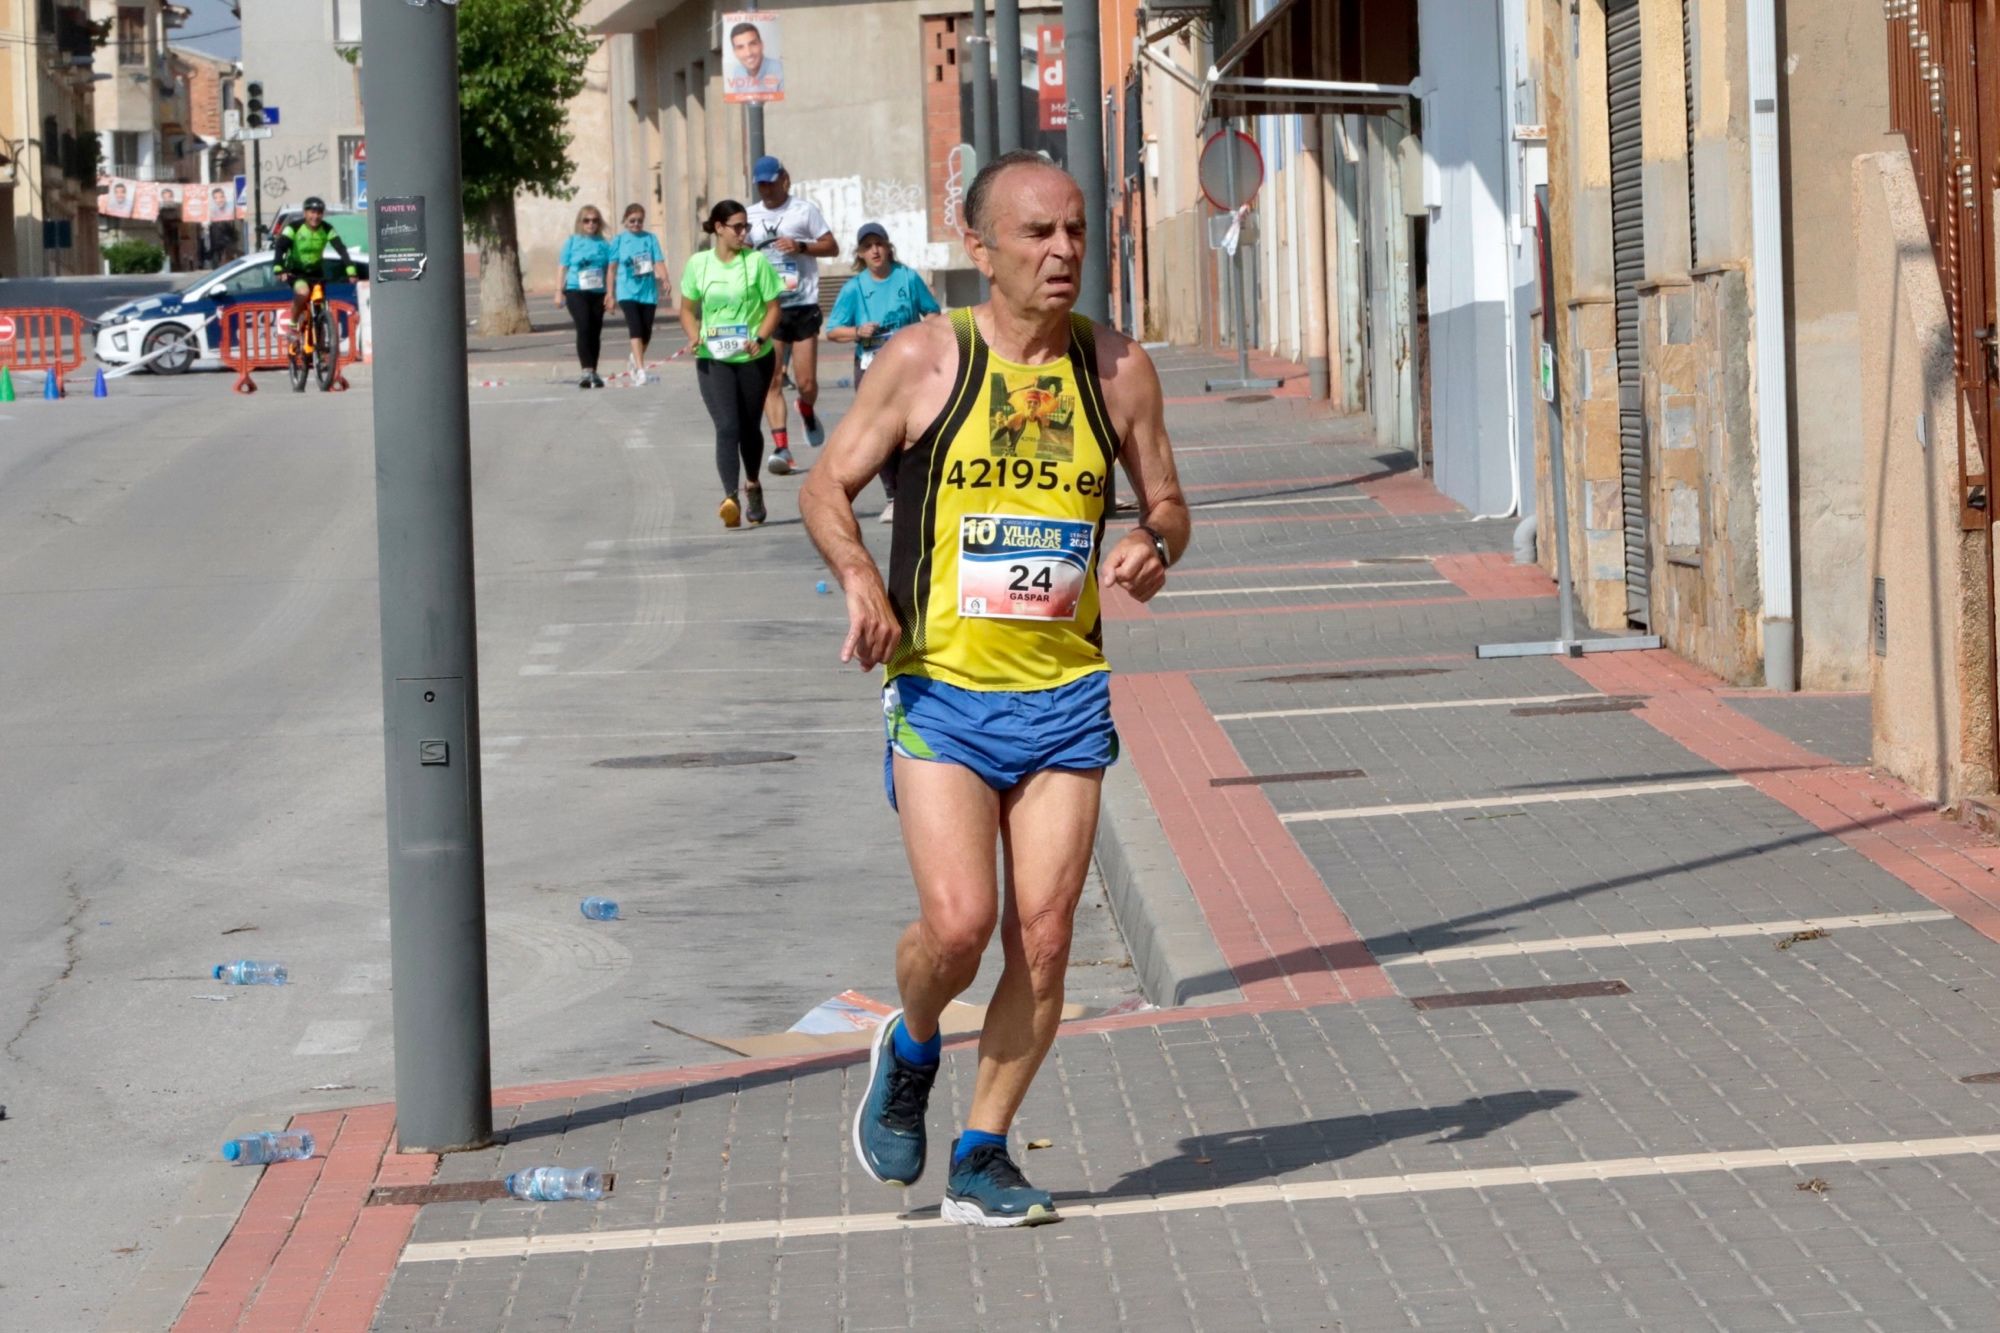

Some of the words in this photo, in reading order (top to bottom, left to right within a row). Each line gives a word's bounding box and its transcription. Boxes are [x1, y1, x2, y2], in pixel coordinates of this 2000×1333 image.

[717, 340, 738, 350] 389
[946, 458, 1105, 498] 42195.es
[1002, 525, 1043, 539] VILLA
[1044, 528, 1062, 541] DE
[1002, 536, 1062, 549] ALGUAZAS
[1069, 538, 1089, 548] 2023
[1008, 564, 1053, 593] 24
[1009, 592, 1050, 602] GASPAR
